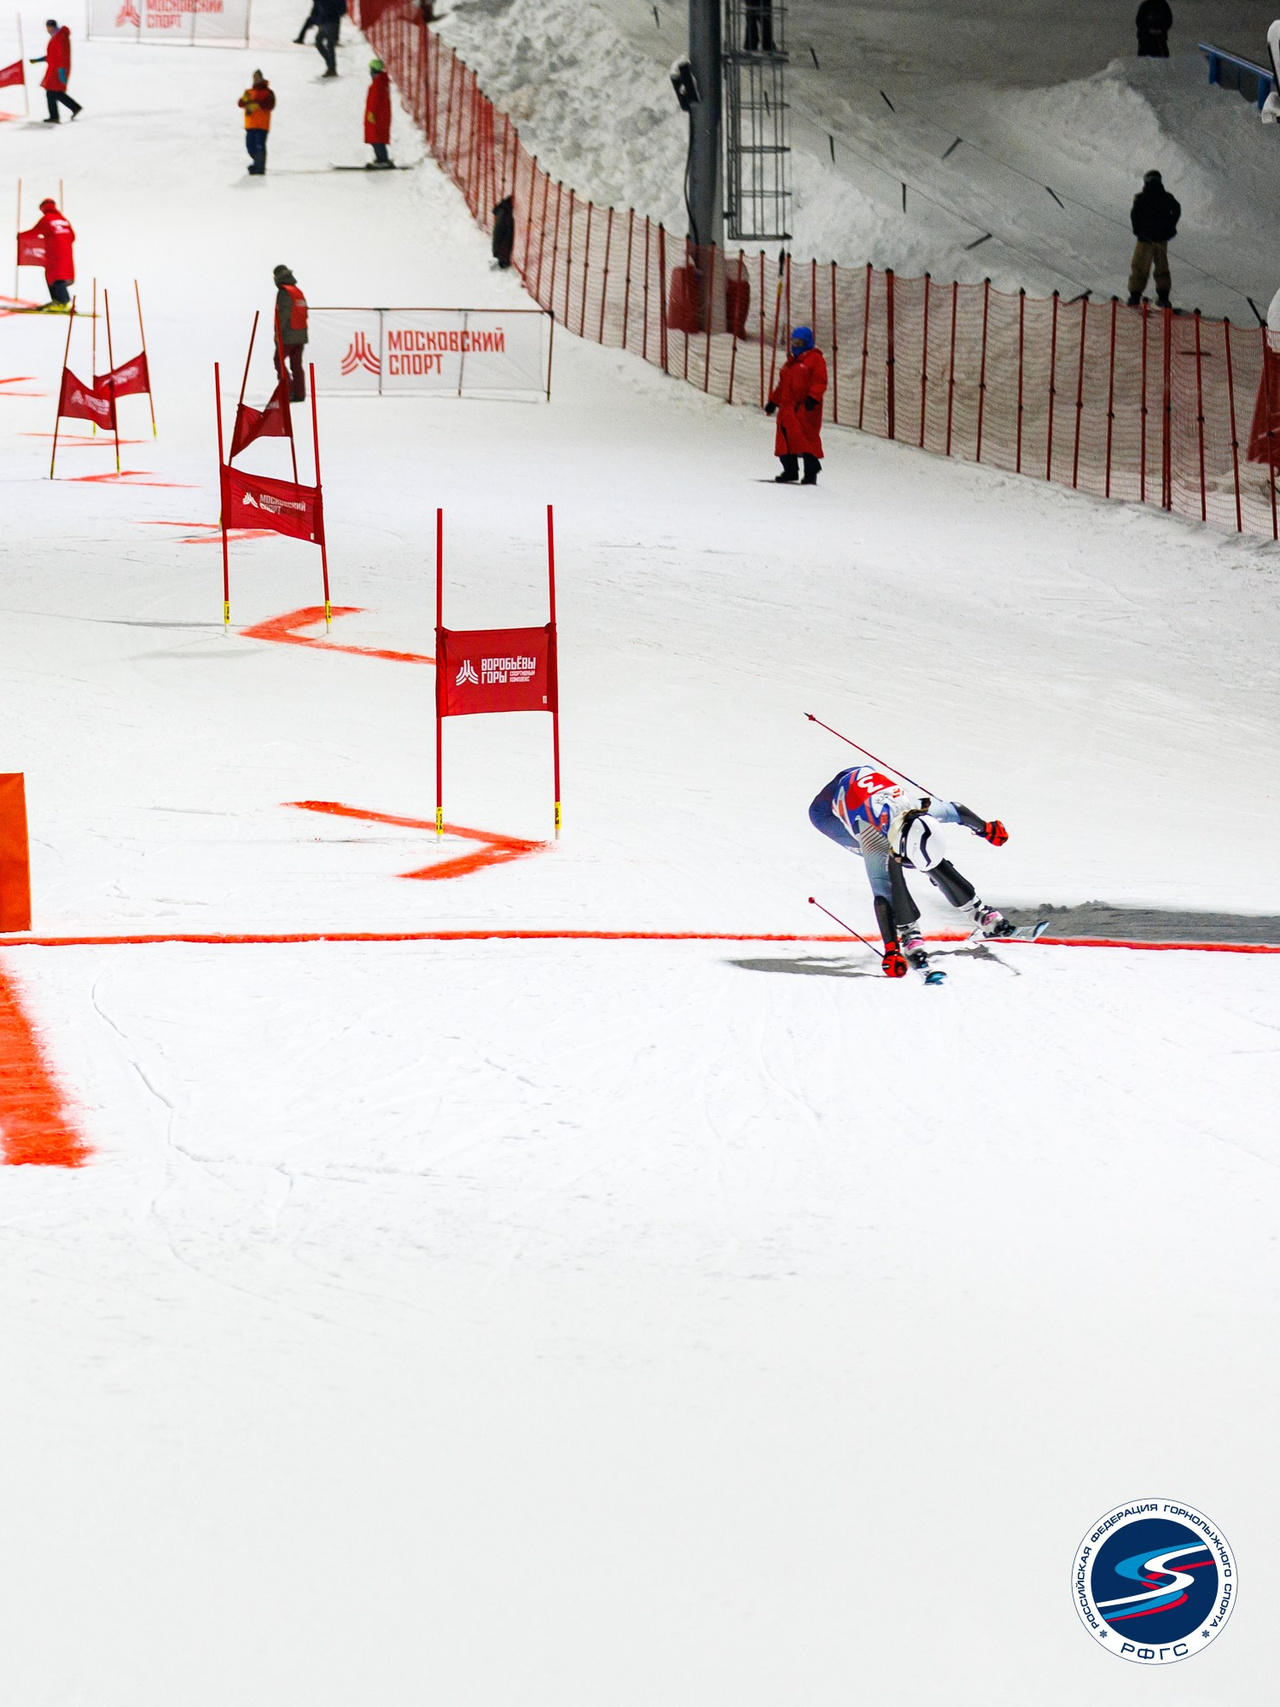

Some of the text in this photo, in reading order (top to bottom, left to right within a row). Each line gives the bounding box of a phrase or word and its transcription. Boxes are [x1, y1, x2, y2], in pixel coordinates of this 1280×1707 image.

[147, 14, 181, 28] СПОРТ
[388, 327, 506, 353] МОСКОВСКИЙ
[389, 354, 444, 375] СПОРТ
[481, 655, 536, 671] ВОРОБЬЁВЫ
[481, 671, 507, 684] ГОРЫ
[857, 776, 885, 794] 3
